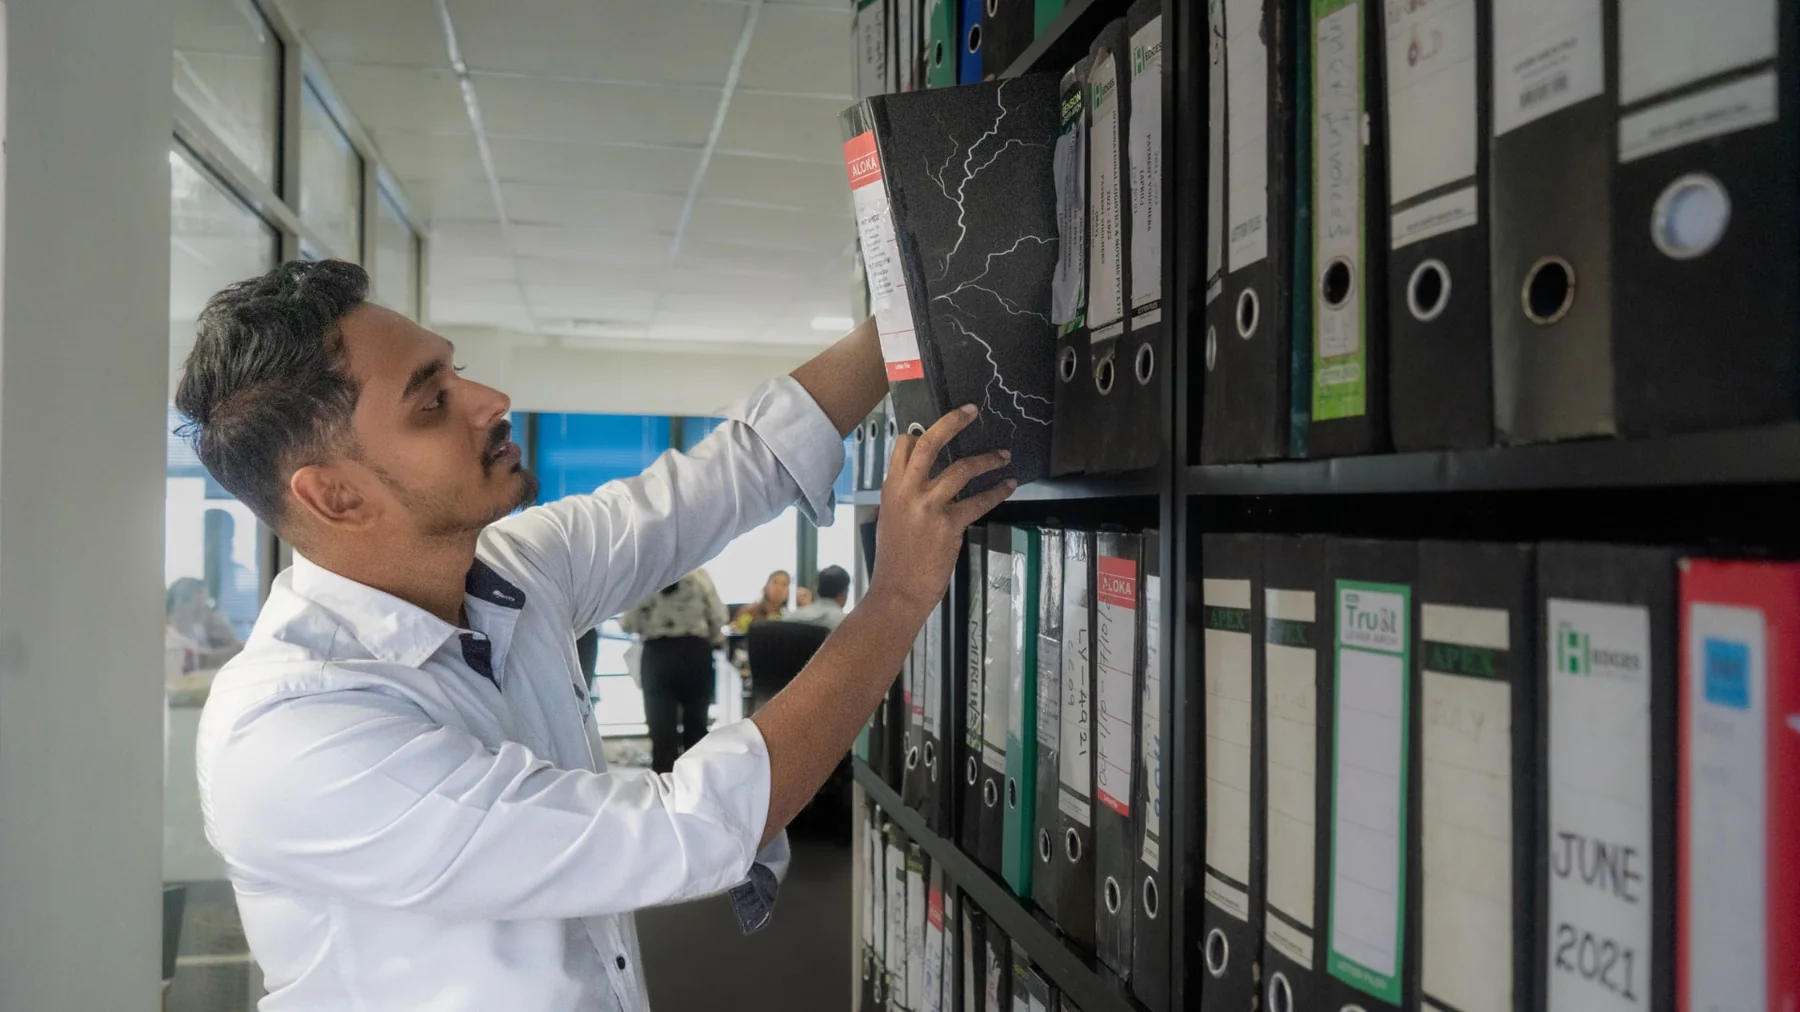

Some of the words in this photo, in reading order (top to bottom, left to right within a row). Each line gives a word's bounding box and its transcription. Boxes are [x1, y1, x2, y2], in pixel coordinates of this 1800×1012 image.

[852, 156, 878, 177] ALOKA
[1210, 608, 1245, 630] APEX
[1431, 643, 1496, 678] APEX
[1551, 830, 1641, 905] JUNE
[1555, 921, 1639, 1003] 2021
